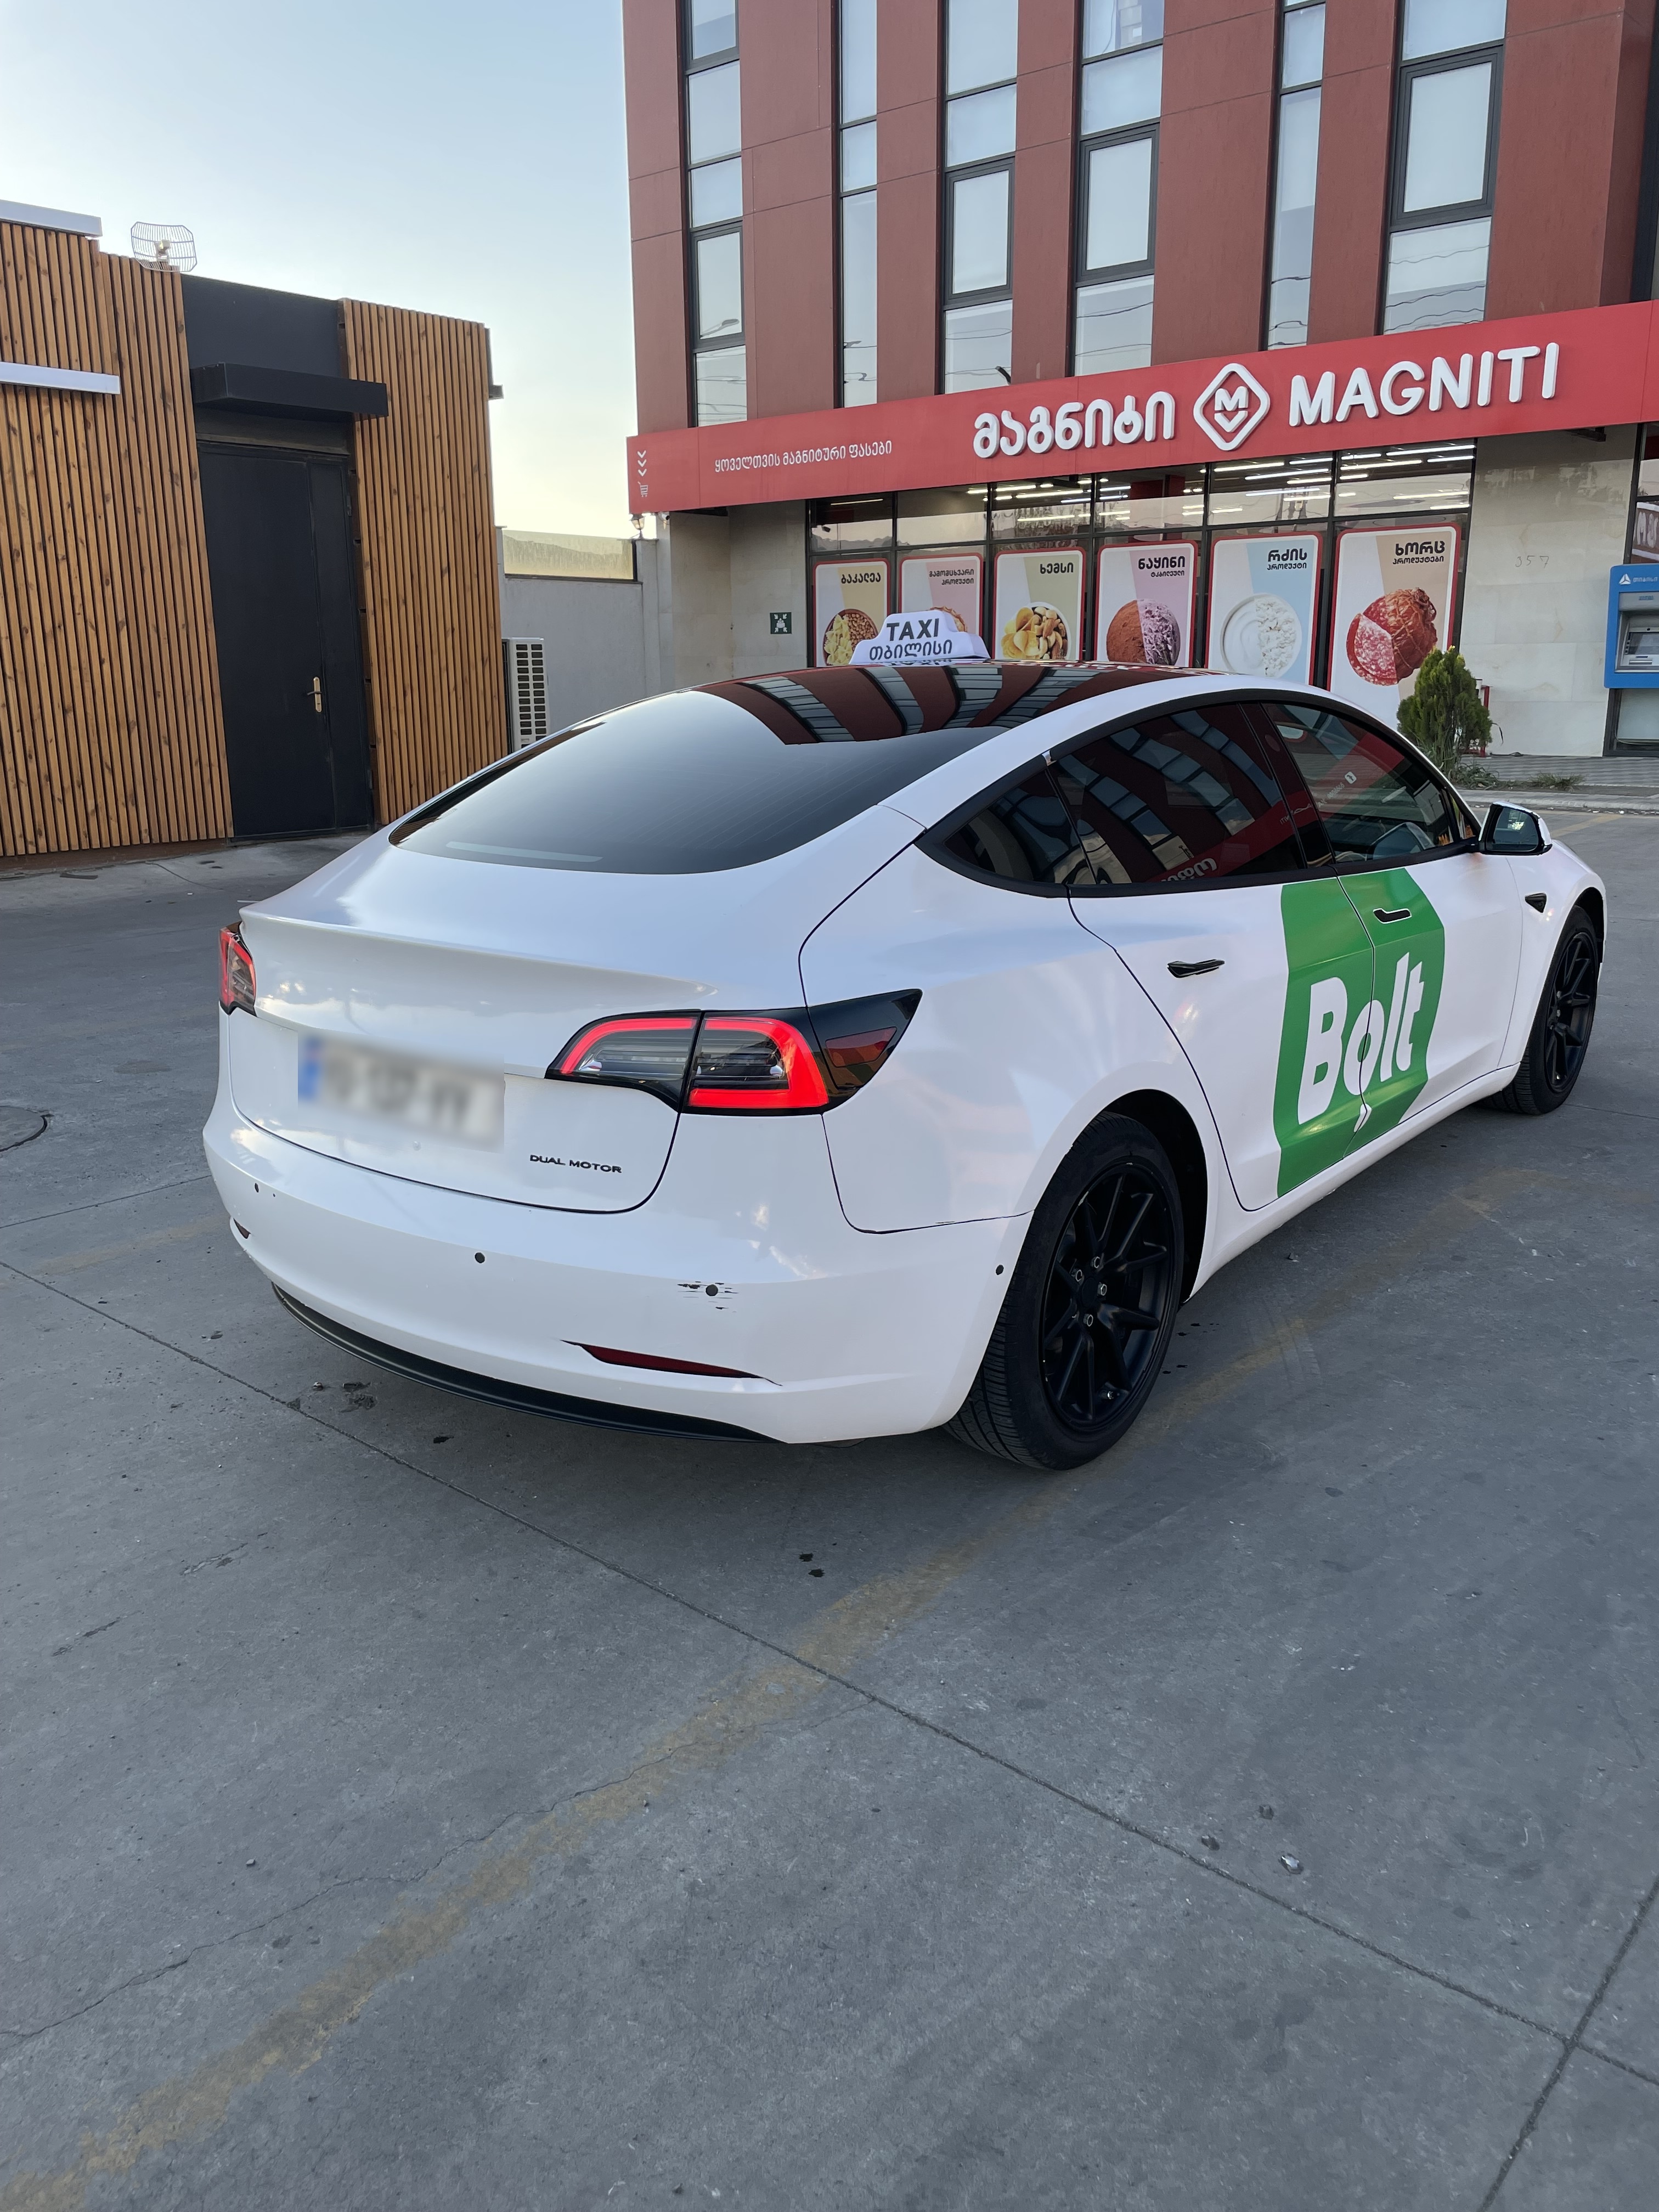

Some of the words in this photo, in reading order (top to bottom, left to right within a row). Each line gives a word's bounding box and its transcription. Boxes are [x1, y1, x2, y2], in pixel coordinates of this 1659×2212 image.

[1289, 342, 1560, 427] MAGNITI
[973, 390, 1176, 459] მაგნიტი
[714, 453, 780, 473] ყოველთვის
[782, 445, 847, 465] მაგნიტური
[849, 439, 893, 458] ფასები
[1268, 548, 1307, 562] რძის
[1395, 540, 1445, 556] ხორც
[1040, 562, 1074, 574] ხემსი
[1138, 556, 1185, 569] ნაყინი
[1267, 562, 1307, 571] პროდუქტი
[1392, 555, 1444, 565] პროდუქტები
[841, 572, 881, 584] ბაკალეა
[929, 568, 974, 577] გამომცხვარი
[887, 618, 939, 641] TAXI
[870, 639, 952, 661] თბილისი
[1297, 952, 1424, 1126] Bolt
[530, 1154, 566, 1165] DUAL
[569, 1159, 622, 1173] MOTOR
